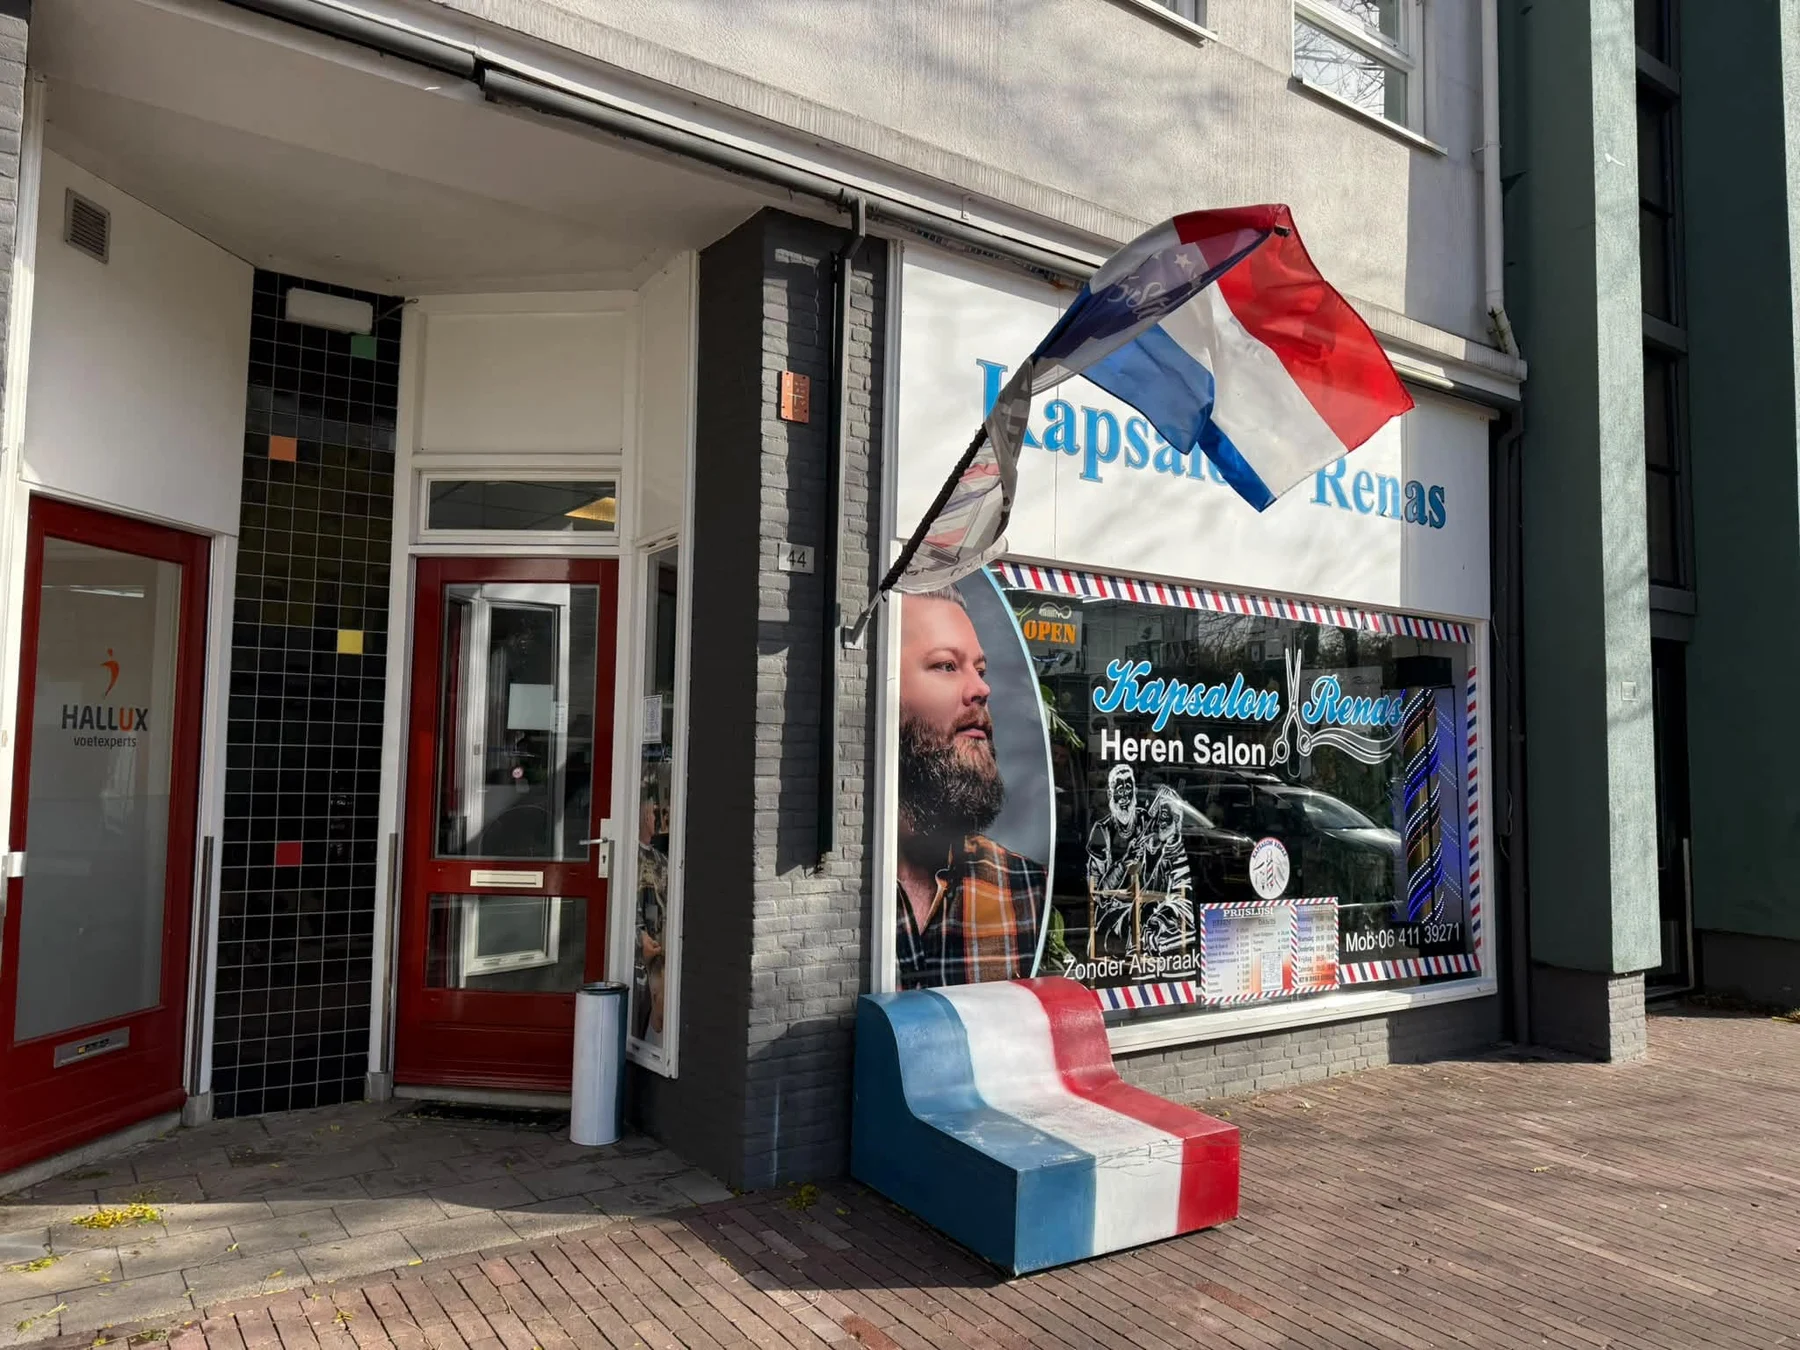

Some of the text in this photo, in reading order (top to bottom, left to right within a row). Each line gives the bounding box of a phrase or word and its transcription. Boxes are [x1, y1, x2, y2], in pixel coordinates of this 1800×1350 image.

[1309, 456, 1447, 530] Renas
[786, 550, 807, 568] 44
[1023, 619, 1077, 645] OPEN
[1093, 658, 1403, 733] Kapsalon Renas
[61, 704, 149, 732] HALLUX
[74, 736, 137, 750] voetexperts
[1100, 728, 1266, 766] Heren Salon
[1398, 927, 1420, 946] 411
[1424, 922, 1460, 944] 39271
[1062, 948, 1201, 980] Zonder Afspraak
